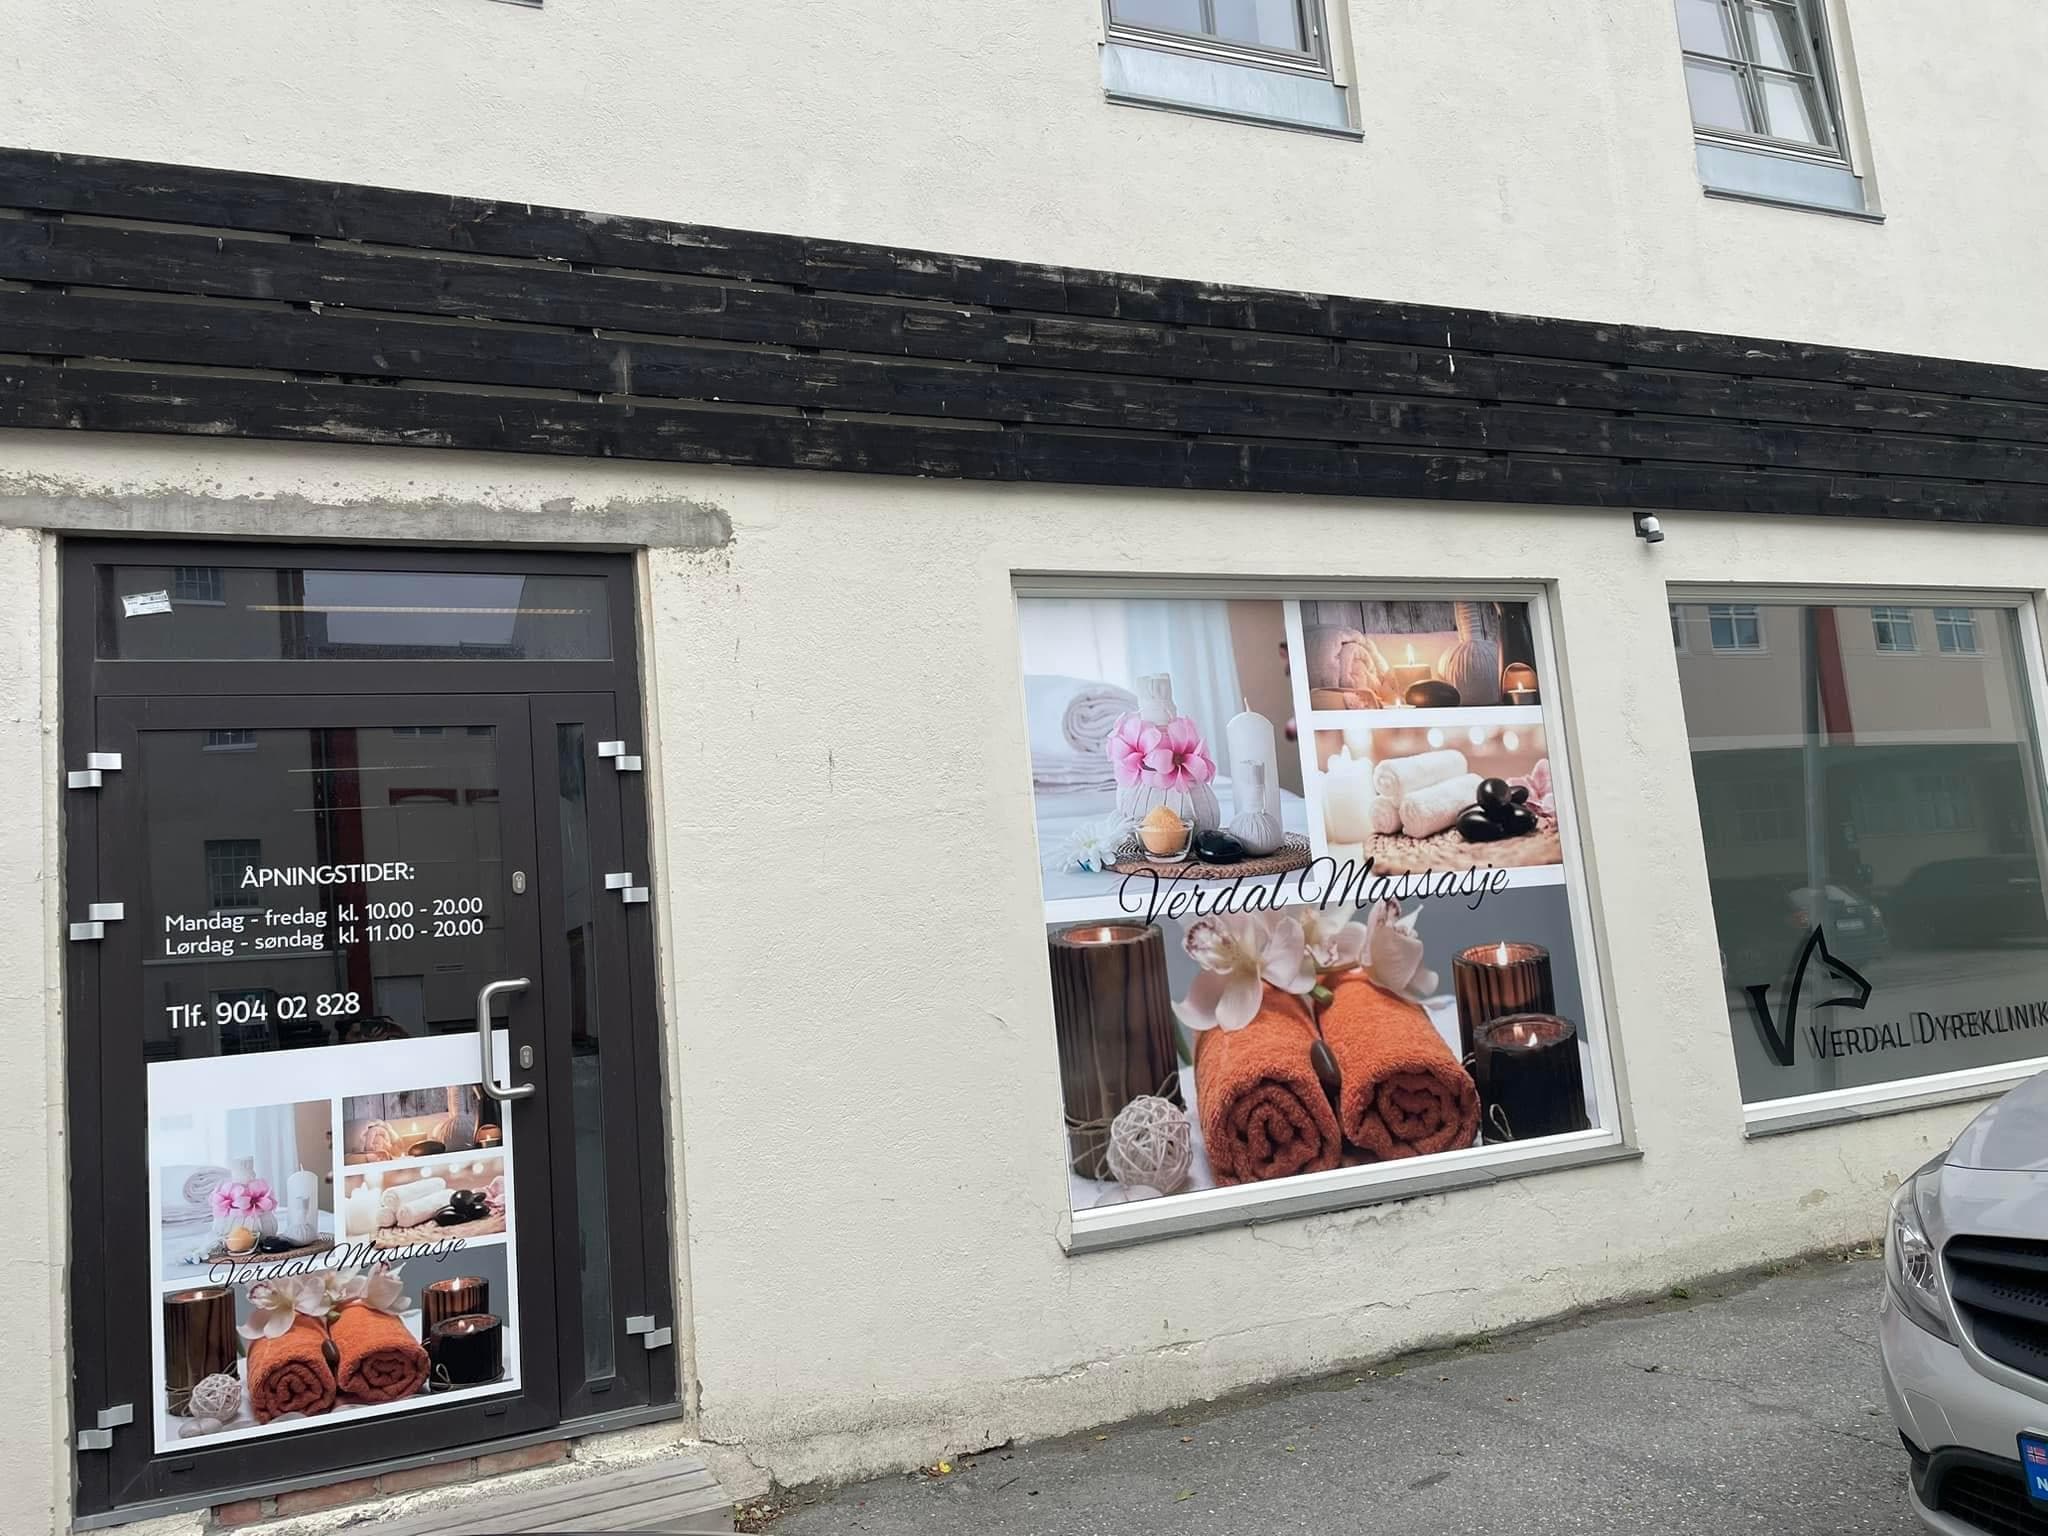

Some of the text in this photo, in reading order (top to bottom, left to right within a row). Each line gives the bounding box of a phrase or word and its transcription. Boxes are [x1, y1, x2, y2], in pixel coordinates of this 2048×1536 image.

[241, 862, 415, 888] ÅPNINGSTIDER:
[1119, 856, 1510, 926] Verdal Massasje
[165, 911, 245, 933] Mandag
[264, 907, 327, 928] fredag
[338, 904, 359, 922] kl.
[365, 901, 414, 919] 10.00
[433, 897, 483, 916] 20.00
[166, 935, 234, 957] Lørdag
[255, 929, 325, 951] søndag
[338, 926, 360, 944] kl.
[365, 923, 414, 942] 11.00
[433, 918, 484, 938] 20.00
[166, 992, 361, 1029] Tlf. 904 02 828
[1810, 1022, 1912, 1059] VERDAL
[208, 1236, 467, 1288] Verdal Massasje
